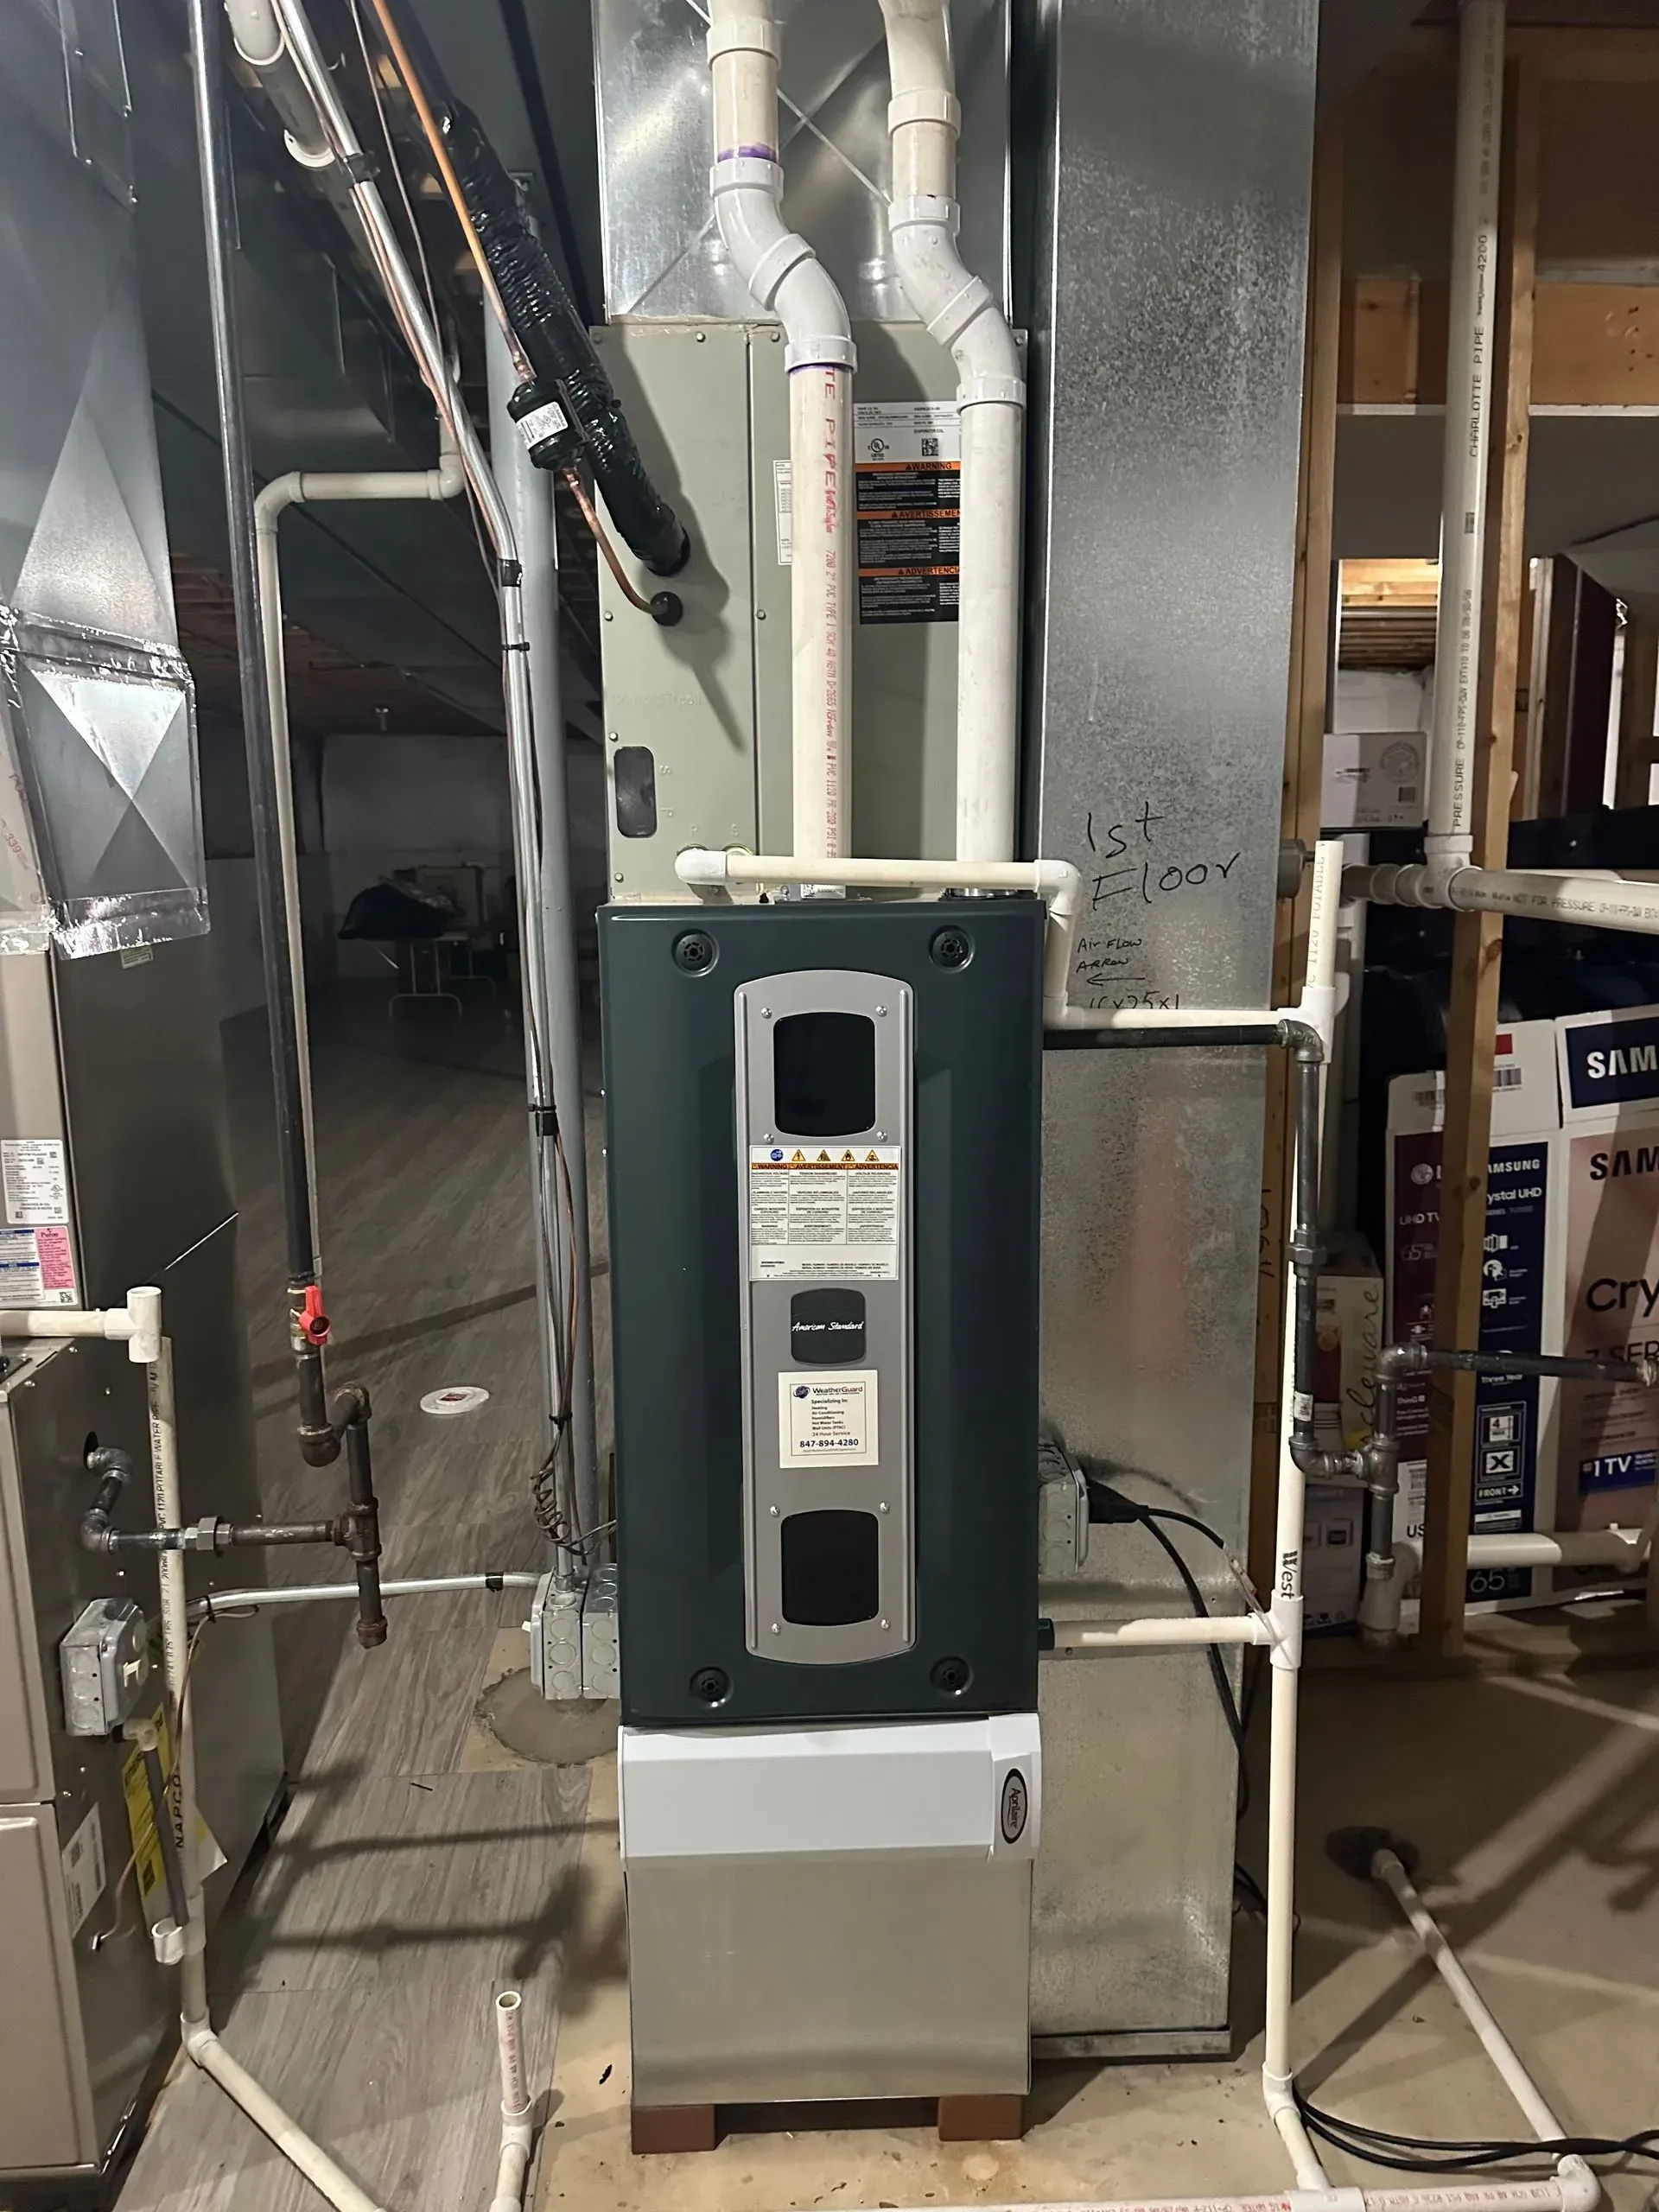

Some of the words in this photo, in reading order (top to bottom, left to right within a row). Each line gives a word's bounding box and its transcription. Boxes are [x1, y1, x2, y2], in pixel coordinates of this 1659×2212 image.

[1474, 326, 1484, 365] PIPE
[824, 368, 836, 399] TE
[1471, 373, 1482, 458] CHARLOTTE
[824, 418, 836, 486] PIPE
[912, 462, 952, 471] WARNING
[826, 601, 836, 619] TYPE
[1452, 758, 1465, 827] PRESSURE
[1087, 801, 1164, 859] 1st
[1092, 852, 1241, 912] Floor
[1586, 1045, 1657, 1080] SAM
[1488, 1159, 1541, 1173] MSUNG
[1487, 1191, 1516, 1205] ystal
[1517, 1187, 1542, 1199] UHD
[1400, 1214, 1425, 1225] UHD
[791, 1321, 825, 1332] American
[827, 1320, 865, 1332] Standard
[799, 1438, 860, 1448] 847-894-4280
[1605, 1455, 1631, 1475] TV
[1478, 1487, 1506, 1498] FRONT
[1281, 1550, 1299, 1601] West
[1008, 1787, 1022, 1829] Aprilaire
